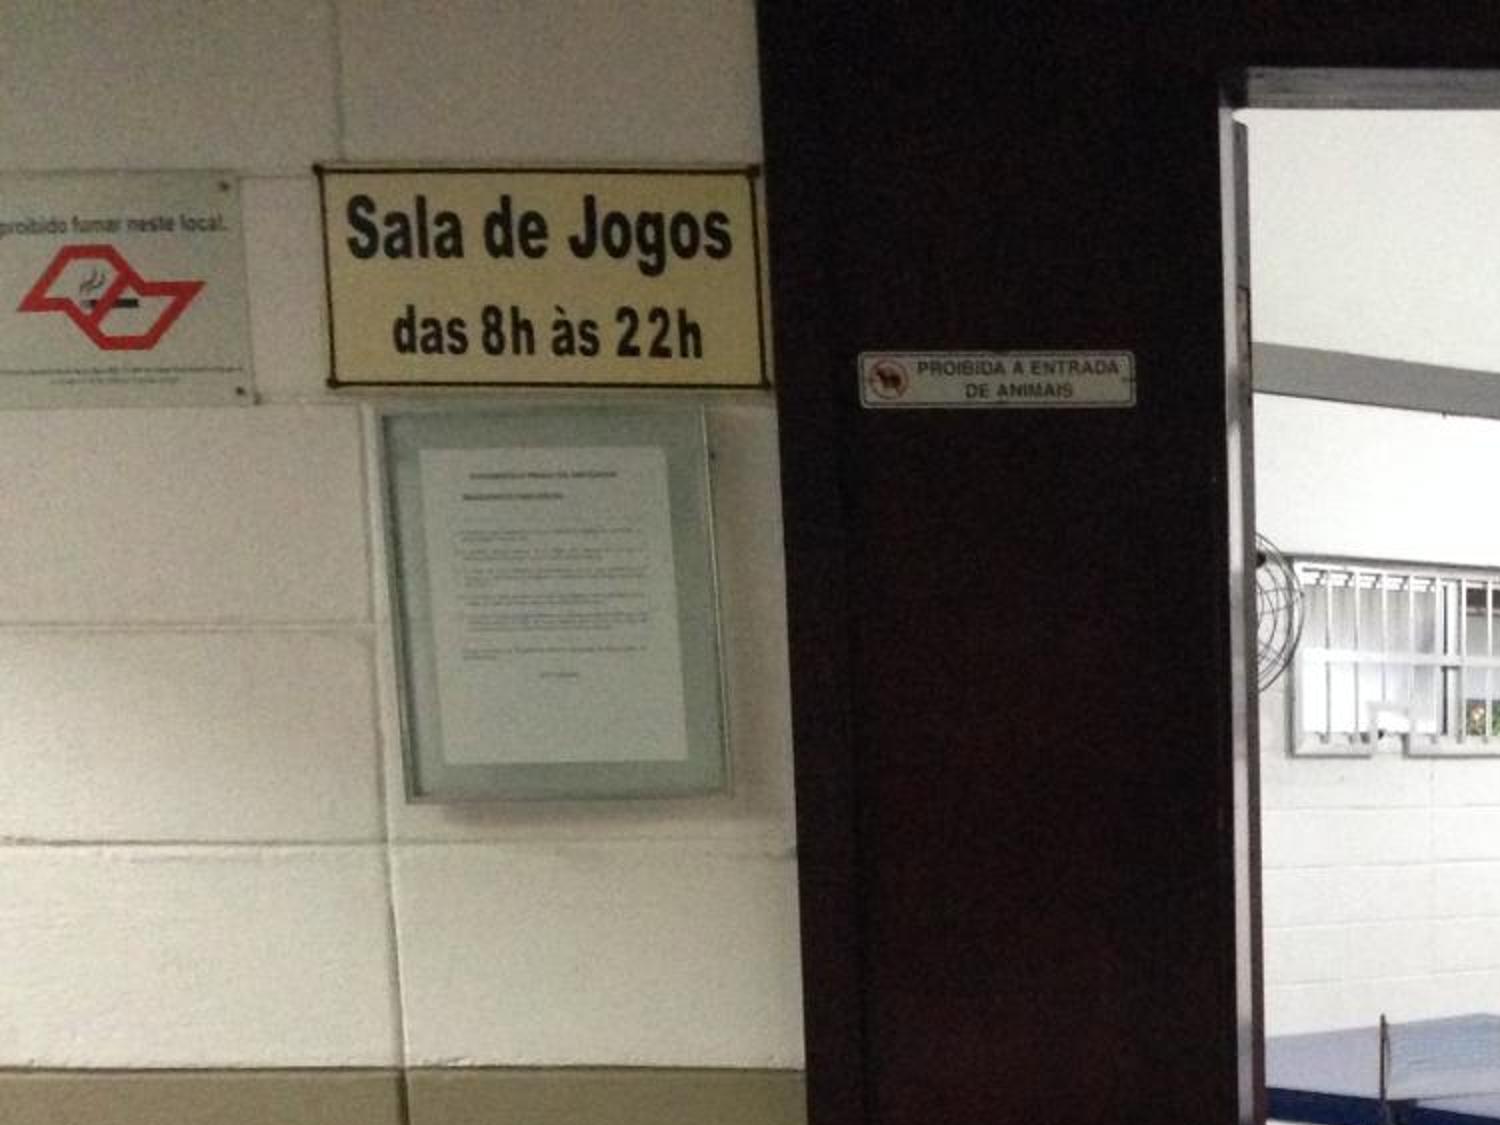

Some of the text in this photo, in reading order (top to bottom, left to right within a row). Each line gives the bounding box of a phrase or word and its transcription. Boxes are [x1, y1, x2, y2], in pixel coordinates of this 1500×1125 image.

[72, 214, 120, 234] fumar
[127, 214, 175, 233] neste
[346, 194, 733, 278] Sala de Jogos
[392, 304, 703, 359] das 8h às 22h
[916, 360, 1120, 377] PROIBIDA A ENTRADA
[964, 382, 1074, 399] DE ANIMAIS
